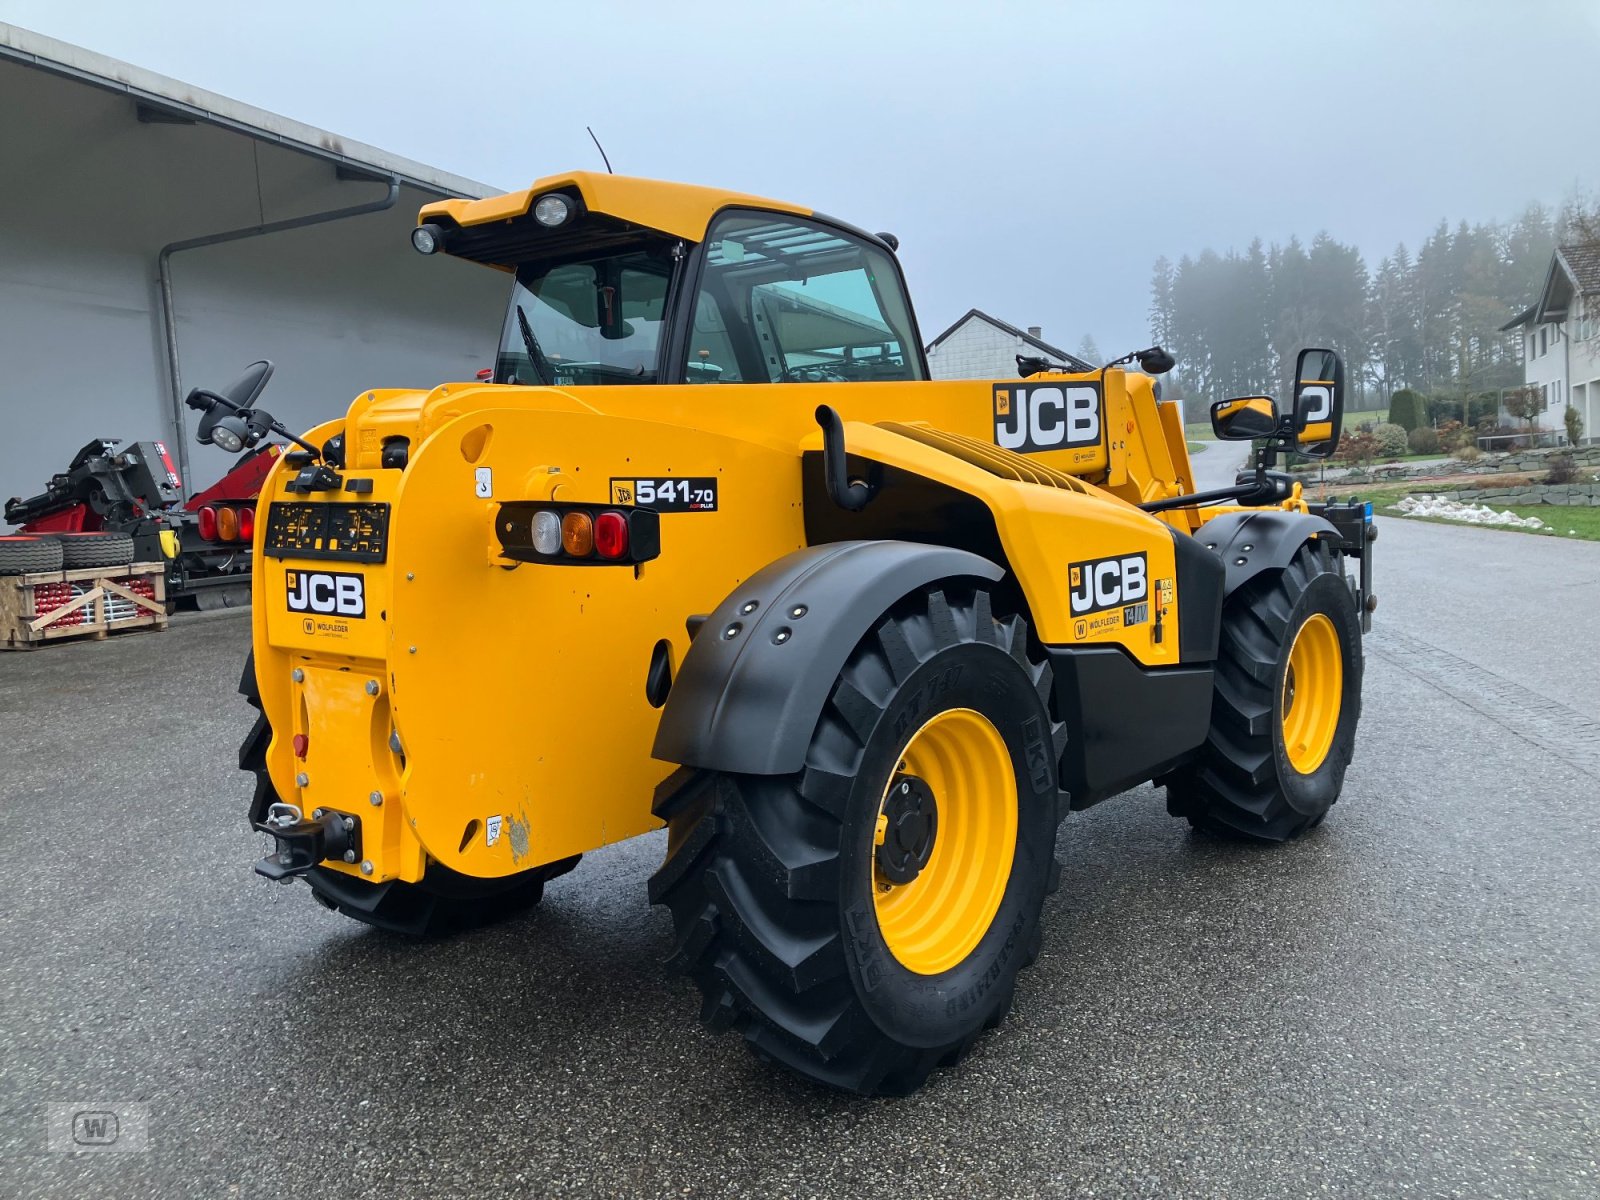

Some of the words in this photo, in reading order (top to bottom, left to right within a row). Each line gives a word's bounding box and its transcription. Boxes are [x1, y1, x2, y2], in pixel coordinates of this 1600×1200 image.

[996, 387, 1099, 449] JCB
[288, 573, 364, 615] JCB
[1071, 556, 1147, 612] JCB
